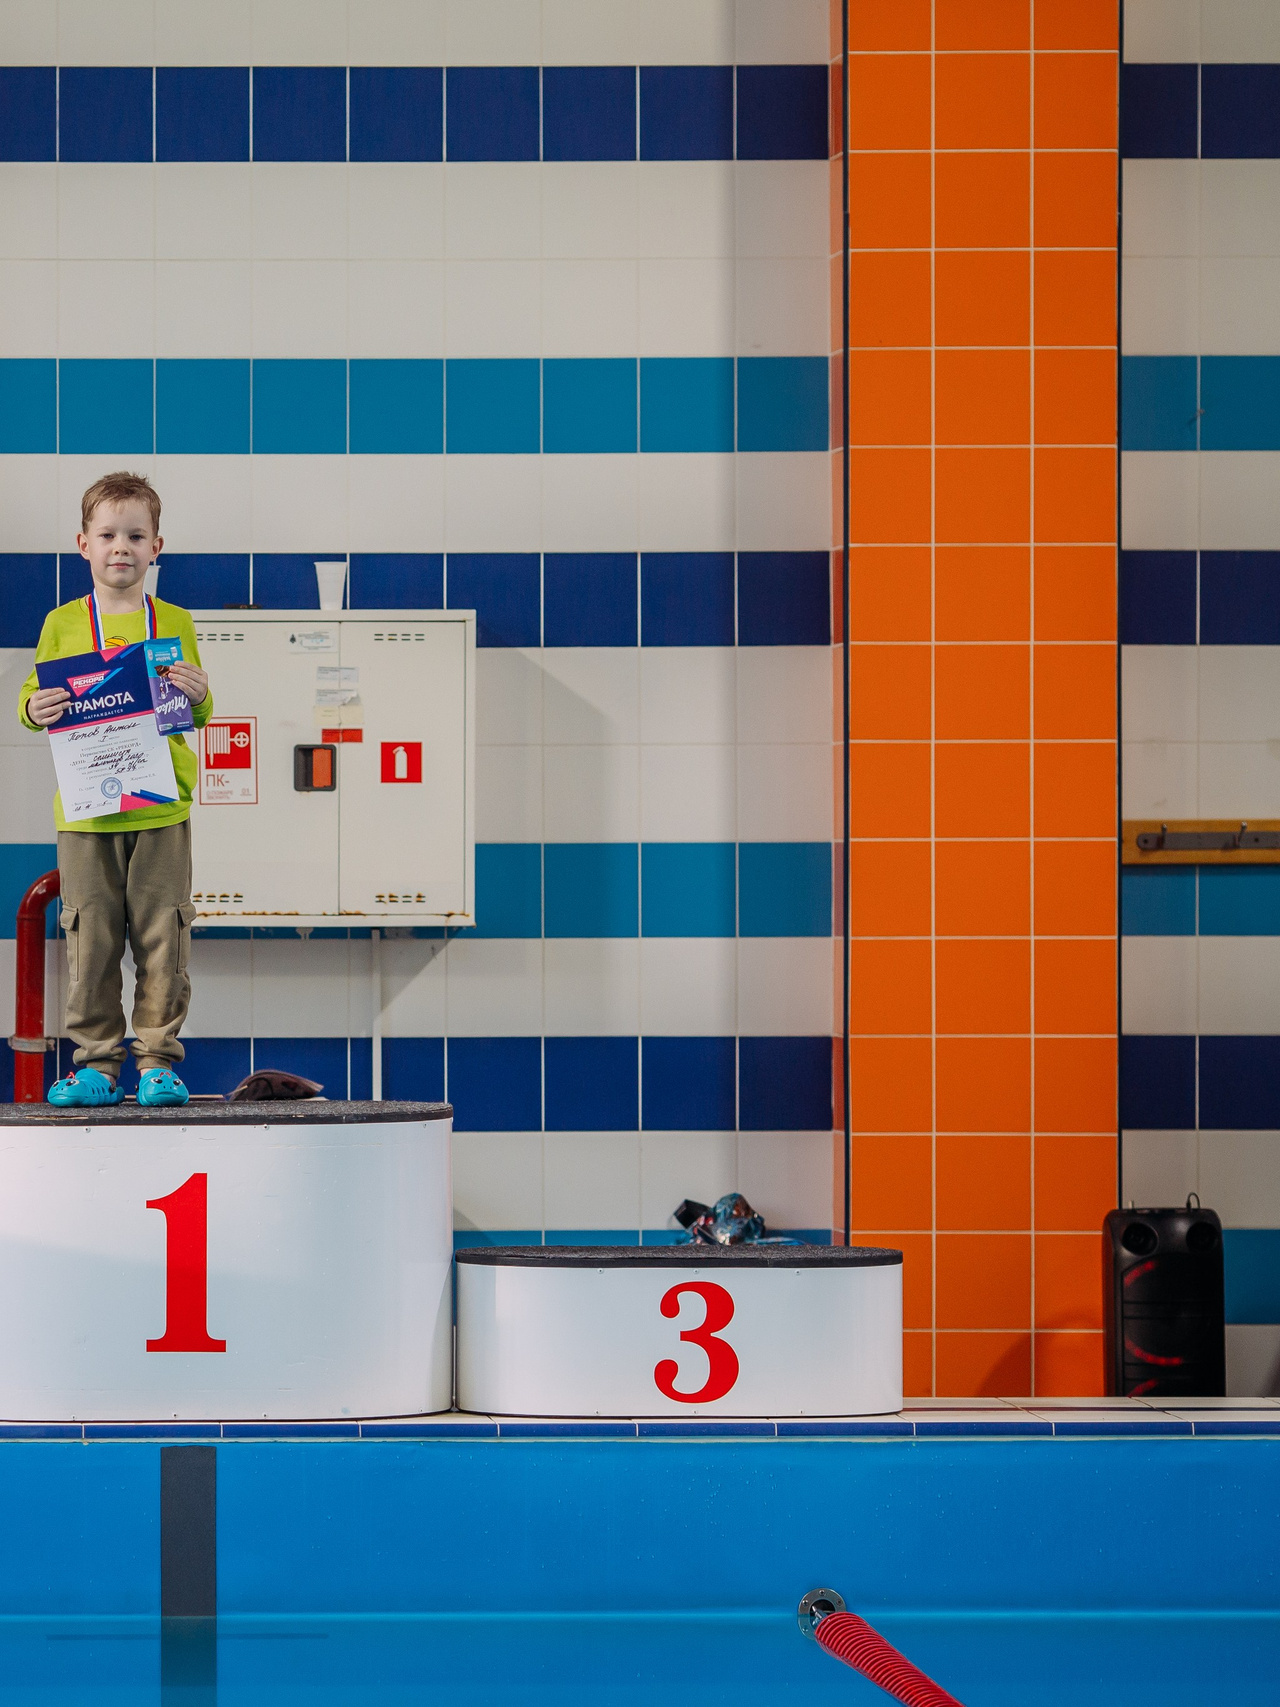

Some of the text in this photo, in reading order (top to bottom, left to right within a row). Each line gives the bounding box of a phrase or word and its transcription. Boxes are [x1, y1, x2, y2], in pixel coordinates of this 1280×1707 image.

[68, 691, 135, 715] ГРАМОТА
[84, 708, 124, 720] НАГРАЖДАЕТСЯ
[155, 694, 188, 715] Milka
[206, 774, 230, 787] ПК-
[147, 1173, 227, 1353] 1
[654, 1282, 739, 1404] 3
